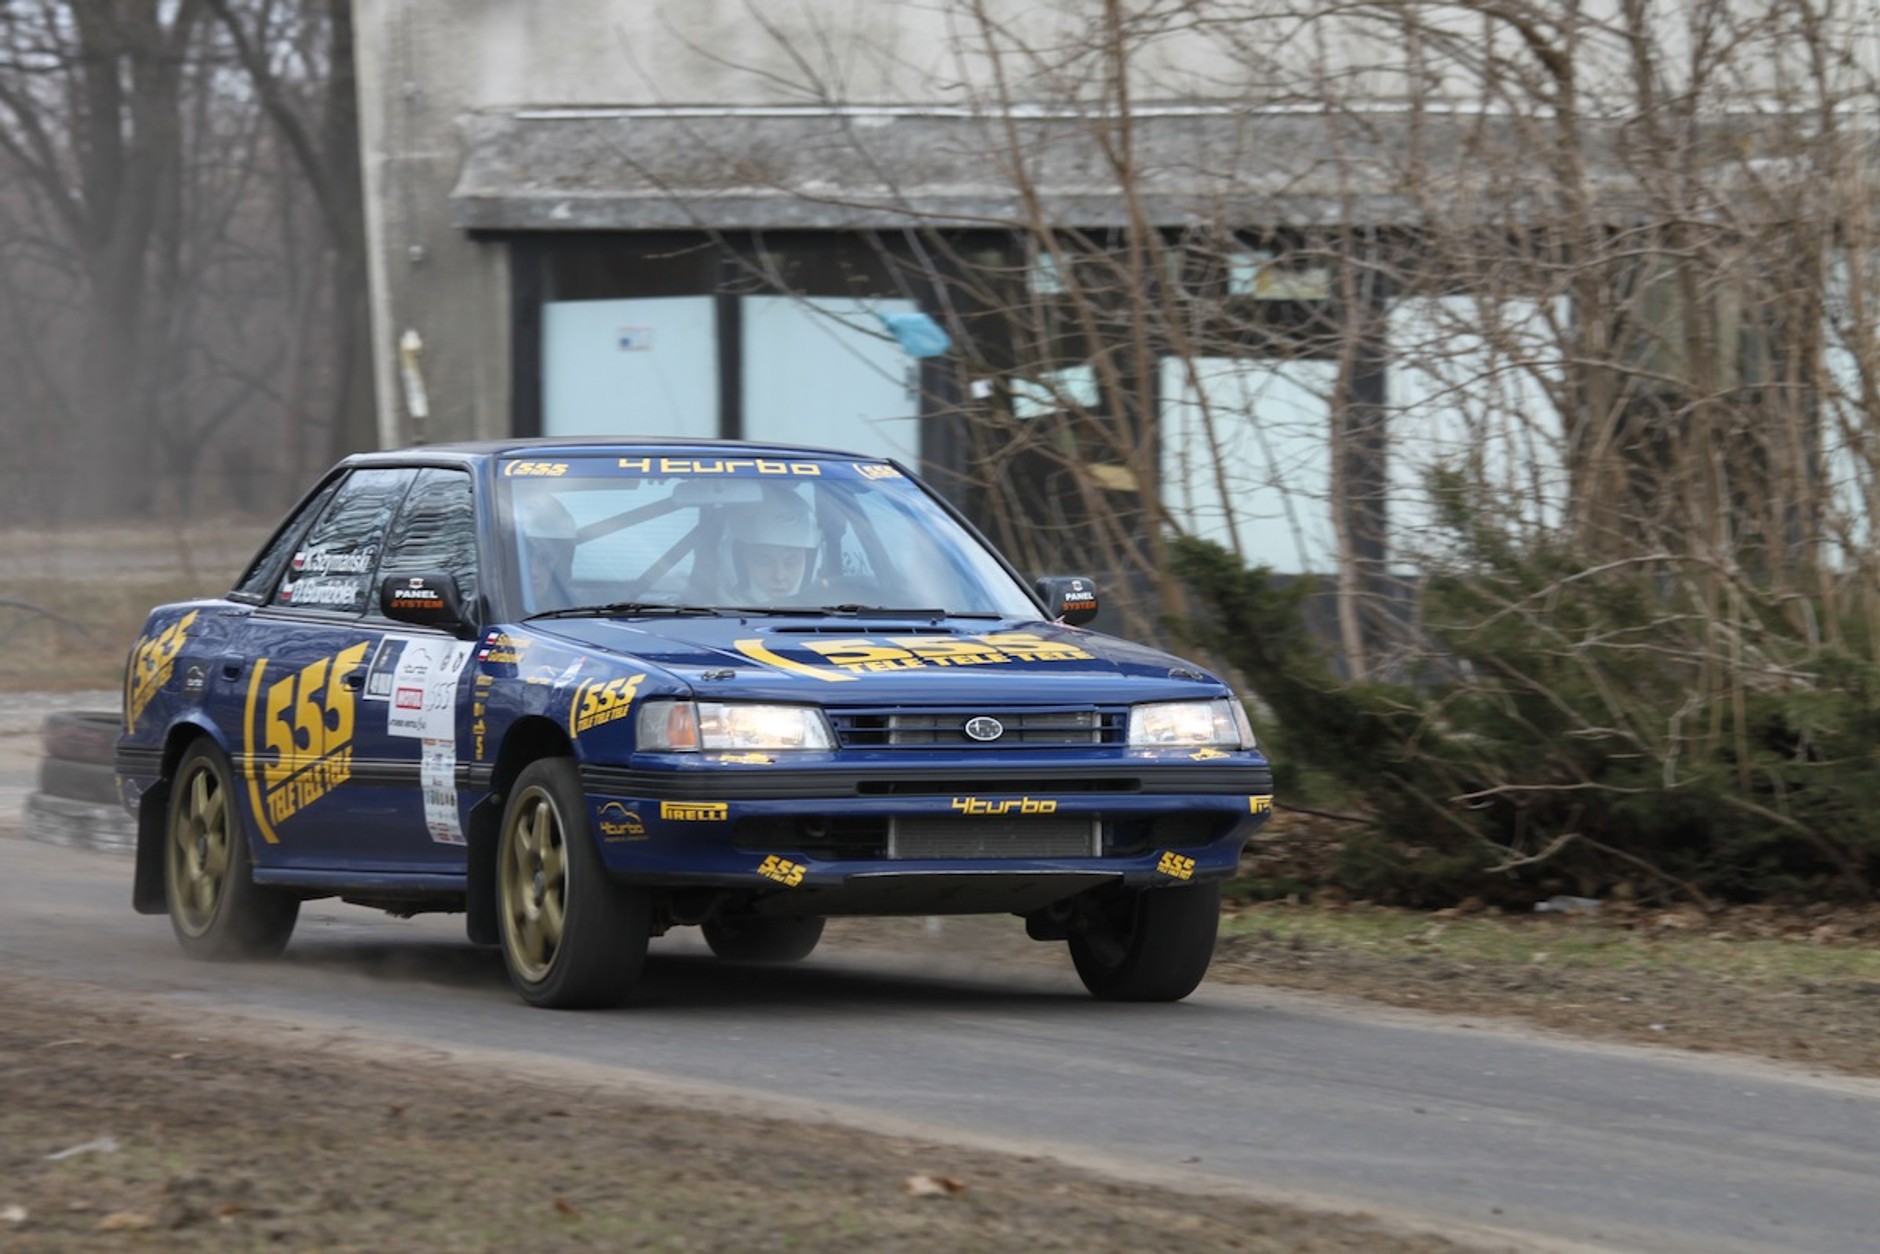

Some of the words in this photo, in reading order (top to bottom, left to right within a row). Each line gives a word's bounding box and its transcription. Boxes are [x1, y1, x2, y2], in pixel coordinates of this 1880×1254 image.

[395, 590, 438, 599] PANEL
[1065, 592, 1094, 601] PANEL
[660, 801, 728, 820] PIRELLI
[951, 796, 1058, 815] 4turbo
